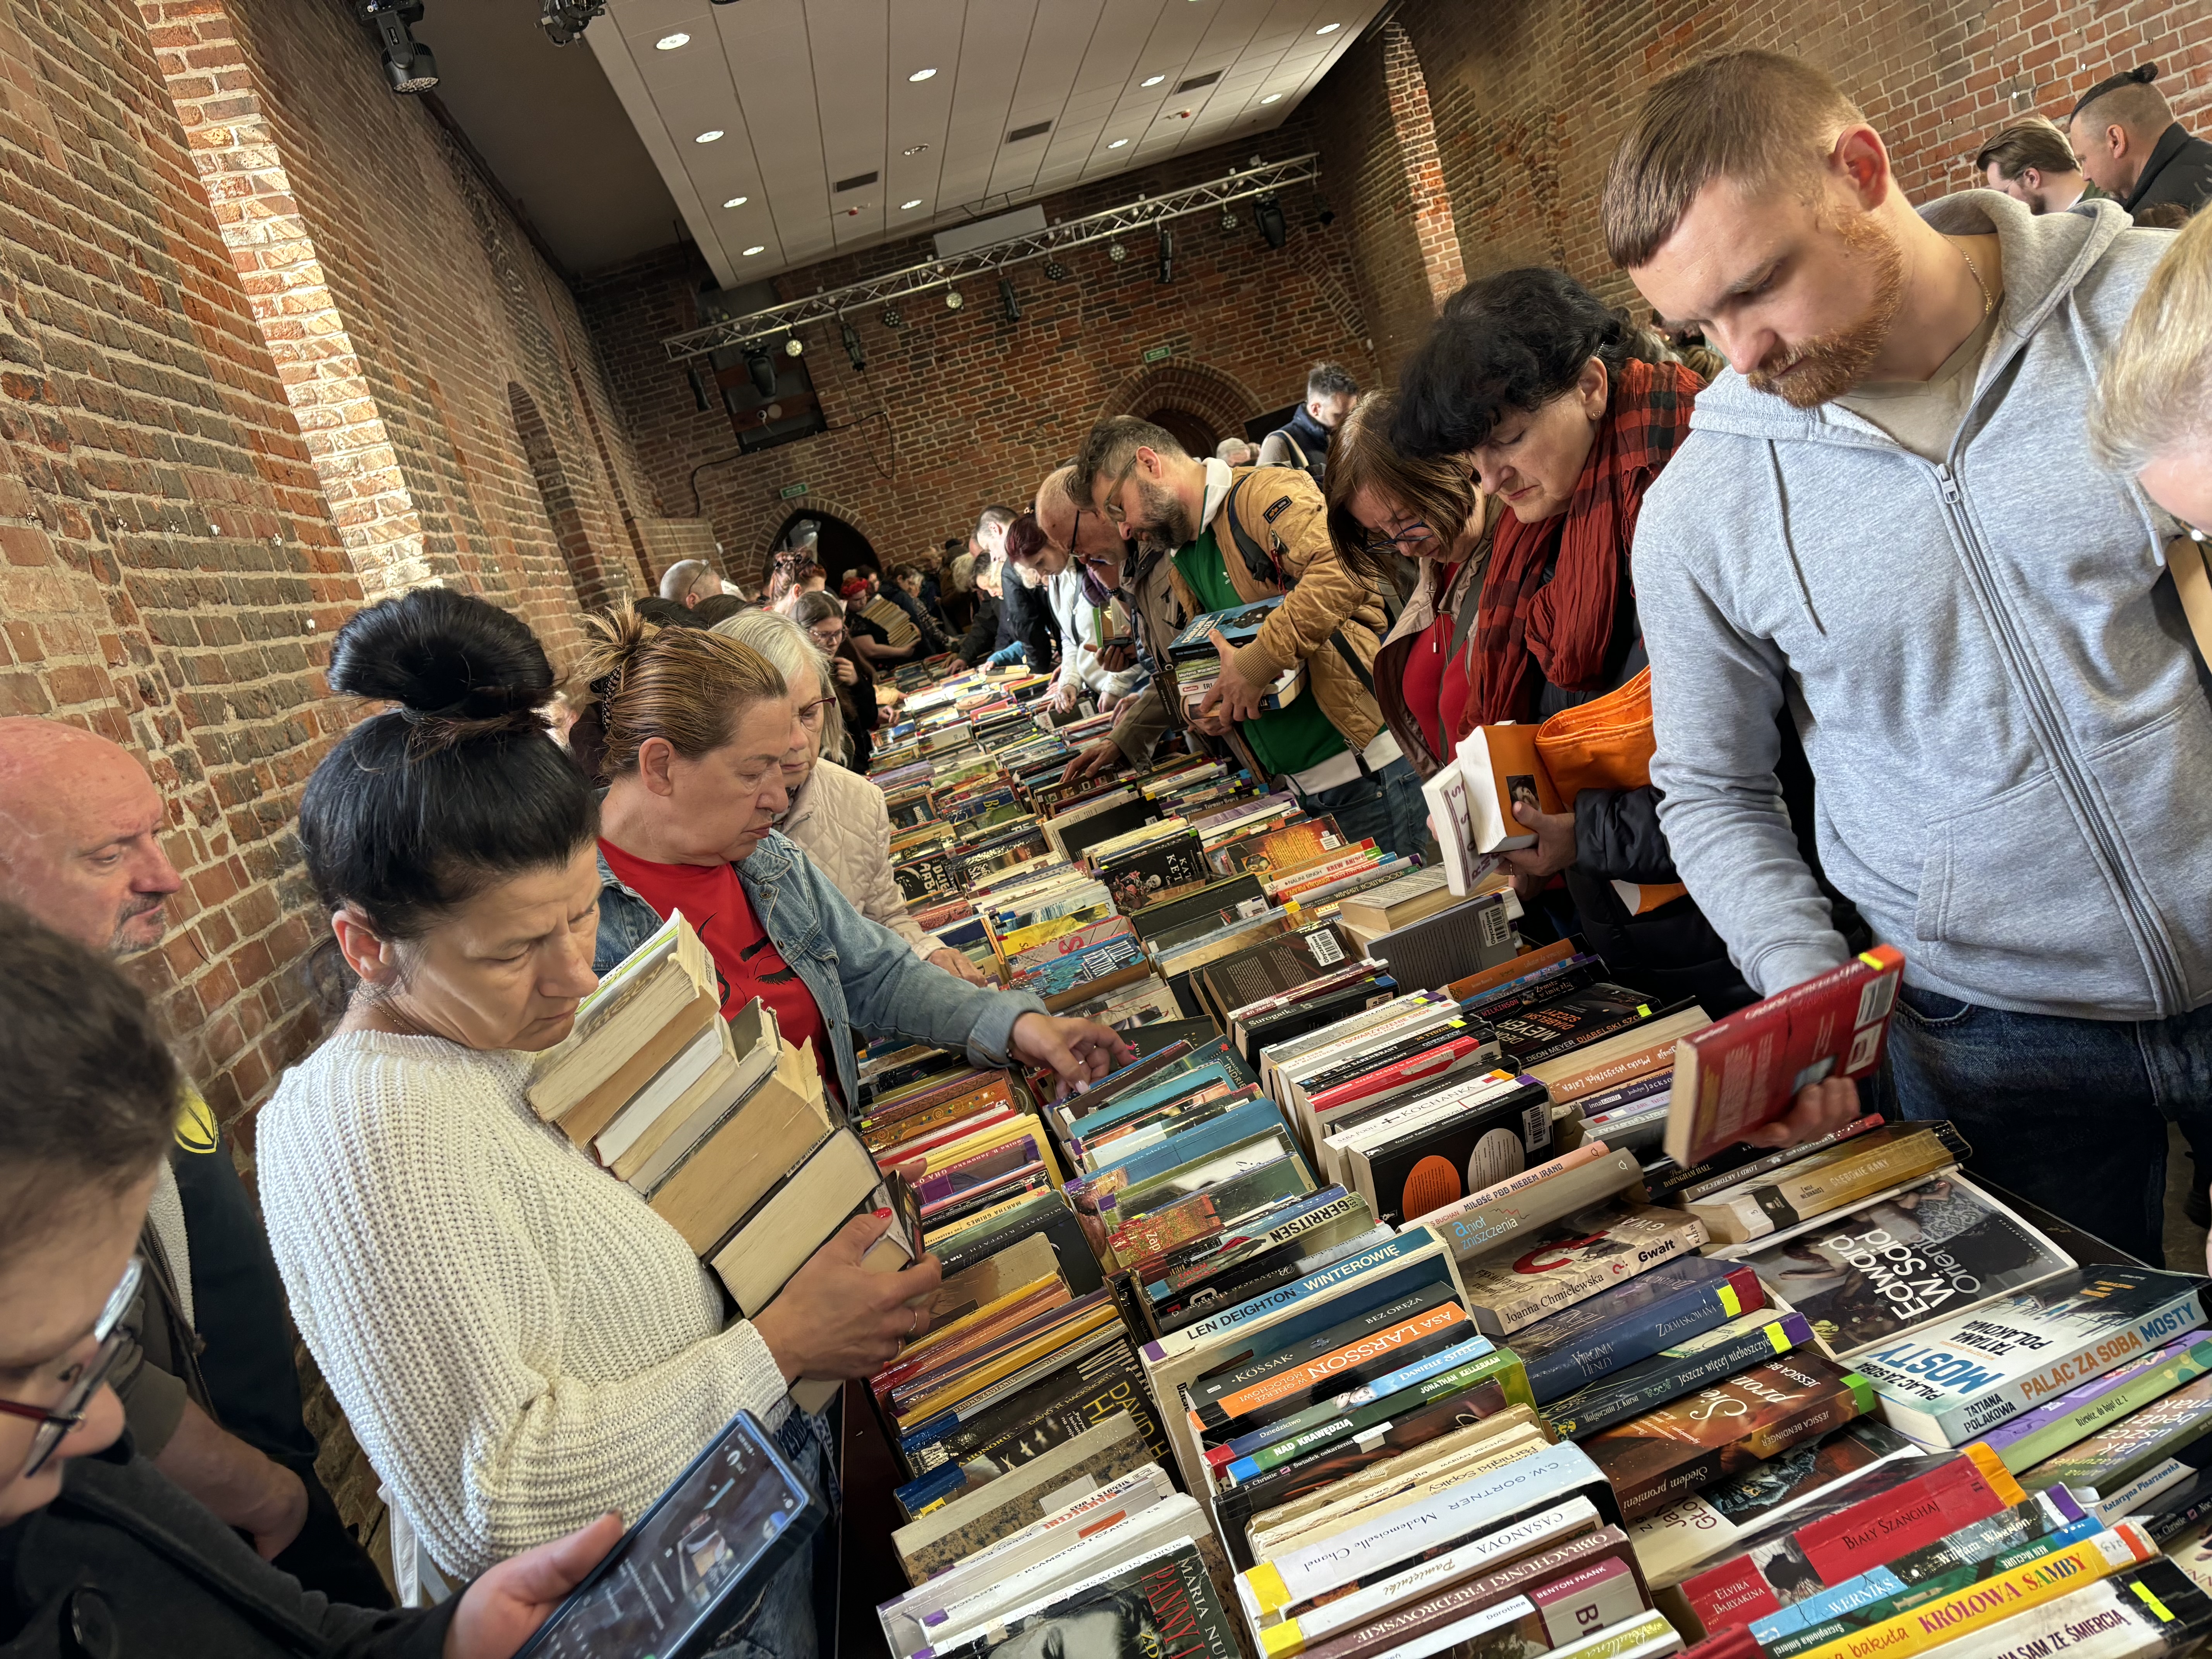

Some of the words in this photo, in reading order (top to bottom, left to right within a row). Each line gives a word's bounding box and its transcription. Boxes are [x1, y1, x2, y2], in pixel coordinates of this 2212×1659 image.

[1326, 862, 1343, 872] KREW
[1486, 911, 1497, 944] Obyczajowa
[1083, 948, 1118, 977] FENTON
[1104, 940, 1135, 968] JULIA
[1312, 936, 1329, 964] Obyczajowa
[1481, 998, 1519, 1017] WILKINSON
[1539, 1008, 1582, 1023] SZCZYT
[1335, 1017, 1408, 1048] STOWARZYSZENIE
[1408, 1008, 1432, 1019] SROK
[1496, 1019, 1561, 1042] MEYER
[1522, 1013, 1575, 1030] DIABELSKI
[1496, 1030, 1525, 1045] DEON
[1525, 1049, 1549, 1063] DEON
[1549, 1040, 1576, 1055] MEYER
[1577, 1022, 1622, 1043] DIABELSKI
[1226, 1056, 1242, 1076] ARNALDUR
[1353, 1046, 1399, 1066] SARENBRANT
[1627, 1055, 1651, 1069] Matka
[1562, 1079, 1585, 1092] Lalek
[1585, 1063, 1627, 1084] Wszystkich
[1401, 1086, 1475, 1116] KOCHANKA
[928, 1169, 948, 1180] GRA
[1663, 1170, 1697, 1187] DARINGHAM
[1697, 1173, 1736, 1193] AKTORECZKA
[1741, 1164, 1758, 1175] LORD
[1463, 1192, 1493, 1212] MIŁOŚĆ
[1493, 1186, 1510, 1199] POD
[1512, 1174, 1539, 1191] NIEBEM
[967, 1212, 993, 1227] GRIMES
[994, 1200, 1022, 1216] MARTHA
[1020, 1207, 1061, 1228] MICHAEL
[1269, 1199, 1352, 1243] GERRITSEN
[1435, 1210, 1460, 1226] BUCHAN
[1452, 1215, 1486, 1237] anioł
[1461, 1216, 1519, 1250] zniszczenia
[1998, 1219, 2027, 1242] CLASSICS
[969, 1229, 1015, 1253] RIDPATH
[1638, 1238, 1676, 1263] Gwałt
[1854, 1228, 1927, 1276] Said
[2028, 1243, 2054, 1264] MODERN
[1178, 1262, 1208, 1279] KRWI
[1238, 1263, 1296, 1291] Bożyszcze
[1475, 1269, 1534, 1293] Chmielewska
[1818, 1234, 1930, 1320] Edward
[1187, 1290, 1232, 1311] tłumów
[1472, 1283, 1501, 1297] Joanna
[1506, 1304, 1540, 1324] Joanna
[1540, 1272, 1604, 1309] Chmielewska
[1908, 1273, 1956, 1308] W.
[1187, 1320, 1218, 1341] LEN
[1221, 1288, 1297, 1328] DEIGHTON
[1364, 1313, 1385, 1325] BEZ
[1386, 1297, 1423, 1316] ORĘŻA
[1422, 1310, 1451, 1329] ÅSA
[1656, 1304, 1717, 1338] ZDEMASKOWANA
[1949, 1331, 2016, 1356] TATIANA
[1961, 1320, 2054, 1350] POLAKOWA
[1307, 1323, 1420, 1379] LARSSON
[1399, 1355, 1443, 1381] DANIELLE
[1444, 1346, 1476, 1362] STEEL
[1571, 1342, 1614, 1366] VIRGINIA
[2020, 1364, 2075, 1401] PALĄC
[2073, 1354, 2099, 1374] ZA
[2097, 1331, 2143, 1364] SOBĄ
[2139, 1302, 2196, 1342] MOSTY
[1235, 1354, 1293, 1382] KOSSAK
[1420, 1374, 1458, 1394] JONATHAN
[1460, 1355, 1501, 1377] KELLERMAN
[1582, 1358, 1613, 1377] HENLEY
[1778, 1365, 1822, 1388] JESSICA
[1866, 1343, 2005, 1395] MOSTY
[980, 1377, 1017, 1400] ZAUFANIE
[1239, 1372, 1304, 1402] MOLOCHOWI
[1254, 1383, 1295, 1403] OFIERZE
[1621, 1394, 1639, 1410] Kursa
[1678, 1366, 1705, 1387] Jeszcze
[1705, 1358, 1730, 1373] więcej
[1898, 1376, 1946, 1401] PALĄC
[1028, 1407, 1054, 1426] DAVID
[1065, 1372, 1116, 1405] HACKWORTH
[1108, 1379, 1156, 1439] DAVID
[1964, 1393, 2004, 1417] TATIANA
[1259, 1417, 1302, 1439] Dziedzictwo
[1803, 1410, 1829, 1429] JESSICA
[1964, 1401, 2017, 1433] POLAKOWA
[965, 1433, 1012, 1463] HONORU
[1273, 1442, 1296, 1457] NAD
[1296, 1418, 1354, 1447] KRAWĘDZIĄ
[1761, 1422, 1802, 1447] BENDINGER
[2097, 1441, 2152, 1455] Jak
[1252, 1471, 1278, 1486] Christie
[1293, 1453, 1319, 1469] Świadek
[1320, 1439, 1354, 1458] oskarżenia
[1441, 1453, 1471, 1468] MARIAN
[1532, 1462, 1559, 1477] C.W.
[1429, 1463, 1480, 1495] Soplicy
[1670, 1466, 1708, 1489] Siedem
[2102, 1487, 2138, 1513] Katarzyna
[2137, 1462, 2180, 1491] Pisarzewska
[1449, 1476, 1526, 1511] GORTNER
[1623, 1479, 1667, 1513] promieni
[1353, 1512, 1438, 1550] Mademoiselle
[1475, 1512, 1564, 1555] CASANOVA
[1842, 1528, 1878, 1550] BIAŁY
[1877, 1499, 1941, 1534] SZANGHAJ
[2162, 1516, 2187, 1535] Christie
[998, 1532, 1033, 1550] Robert
[1146, 1542, 1182, 1560] MARIA
[2033, 1544, 2049, 1557] KEN
[947, 1583, 1001, 1613] MORANTE
[1024, 1541, 1086, 1574] KŁAMSTWO
[1095, 1520, 1130, 1539] CZARY
[1304, 1547, 1351, 1572] Chanel
[1490, 1534, 1608, 1589] OBRACHUNKI
[1828, 1578, 1894, 1614] WERNIKS
[1935, 1540, 1980, 1565] William
[1980, 1517, 2031, 1544] Wharton
[2001, 1551, 2033, 1569] McCLURE
[1075, 1560, 1141, 1592] NUROWSKA
[1178, 1558, 1209, 1620] MARIA
[1383, 1558, 1456, 1596] Pamiętniki
[1535, 1578, 1574, 1599] BENTON
[1575, 1565, 1607, 1583] FRANK
[1140, 1562, 1198, 1643] PANNY
[1712, 1587, 1766, 1614] BARYAKINA
[1714, 1581, 1750, 1600] ELVIRA
[1917, 1581, 2023, 1636] KRÓLOWA
[2021, 1553, 2087, 1591] SAMBY
[1353, 1583, 1487, 1644] FREDROWSKIE
[1486, 1601, 1527, 1621] Dorothea
[1801, 1622, 1845, 1650] Szczepionka
[2047, 1630, 2068, 1648] ZE
[2064, 1609, 2131, 1643] ŚMIERCIĄ
